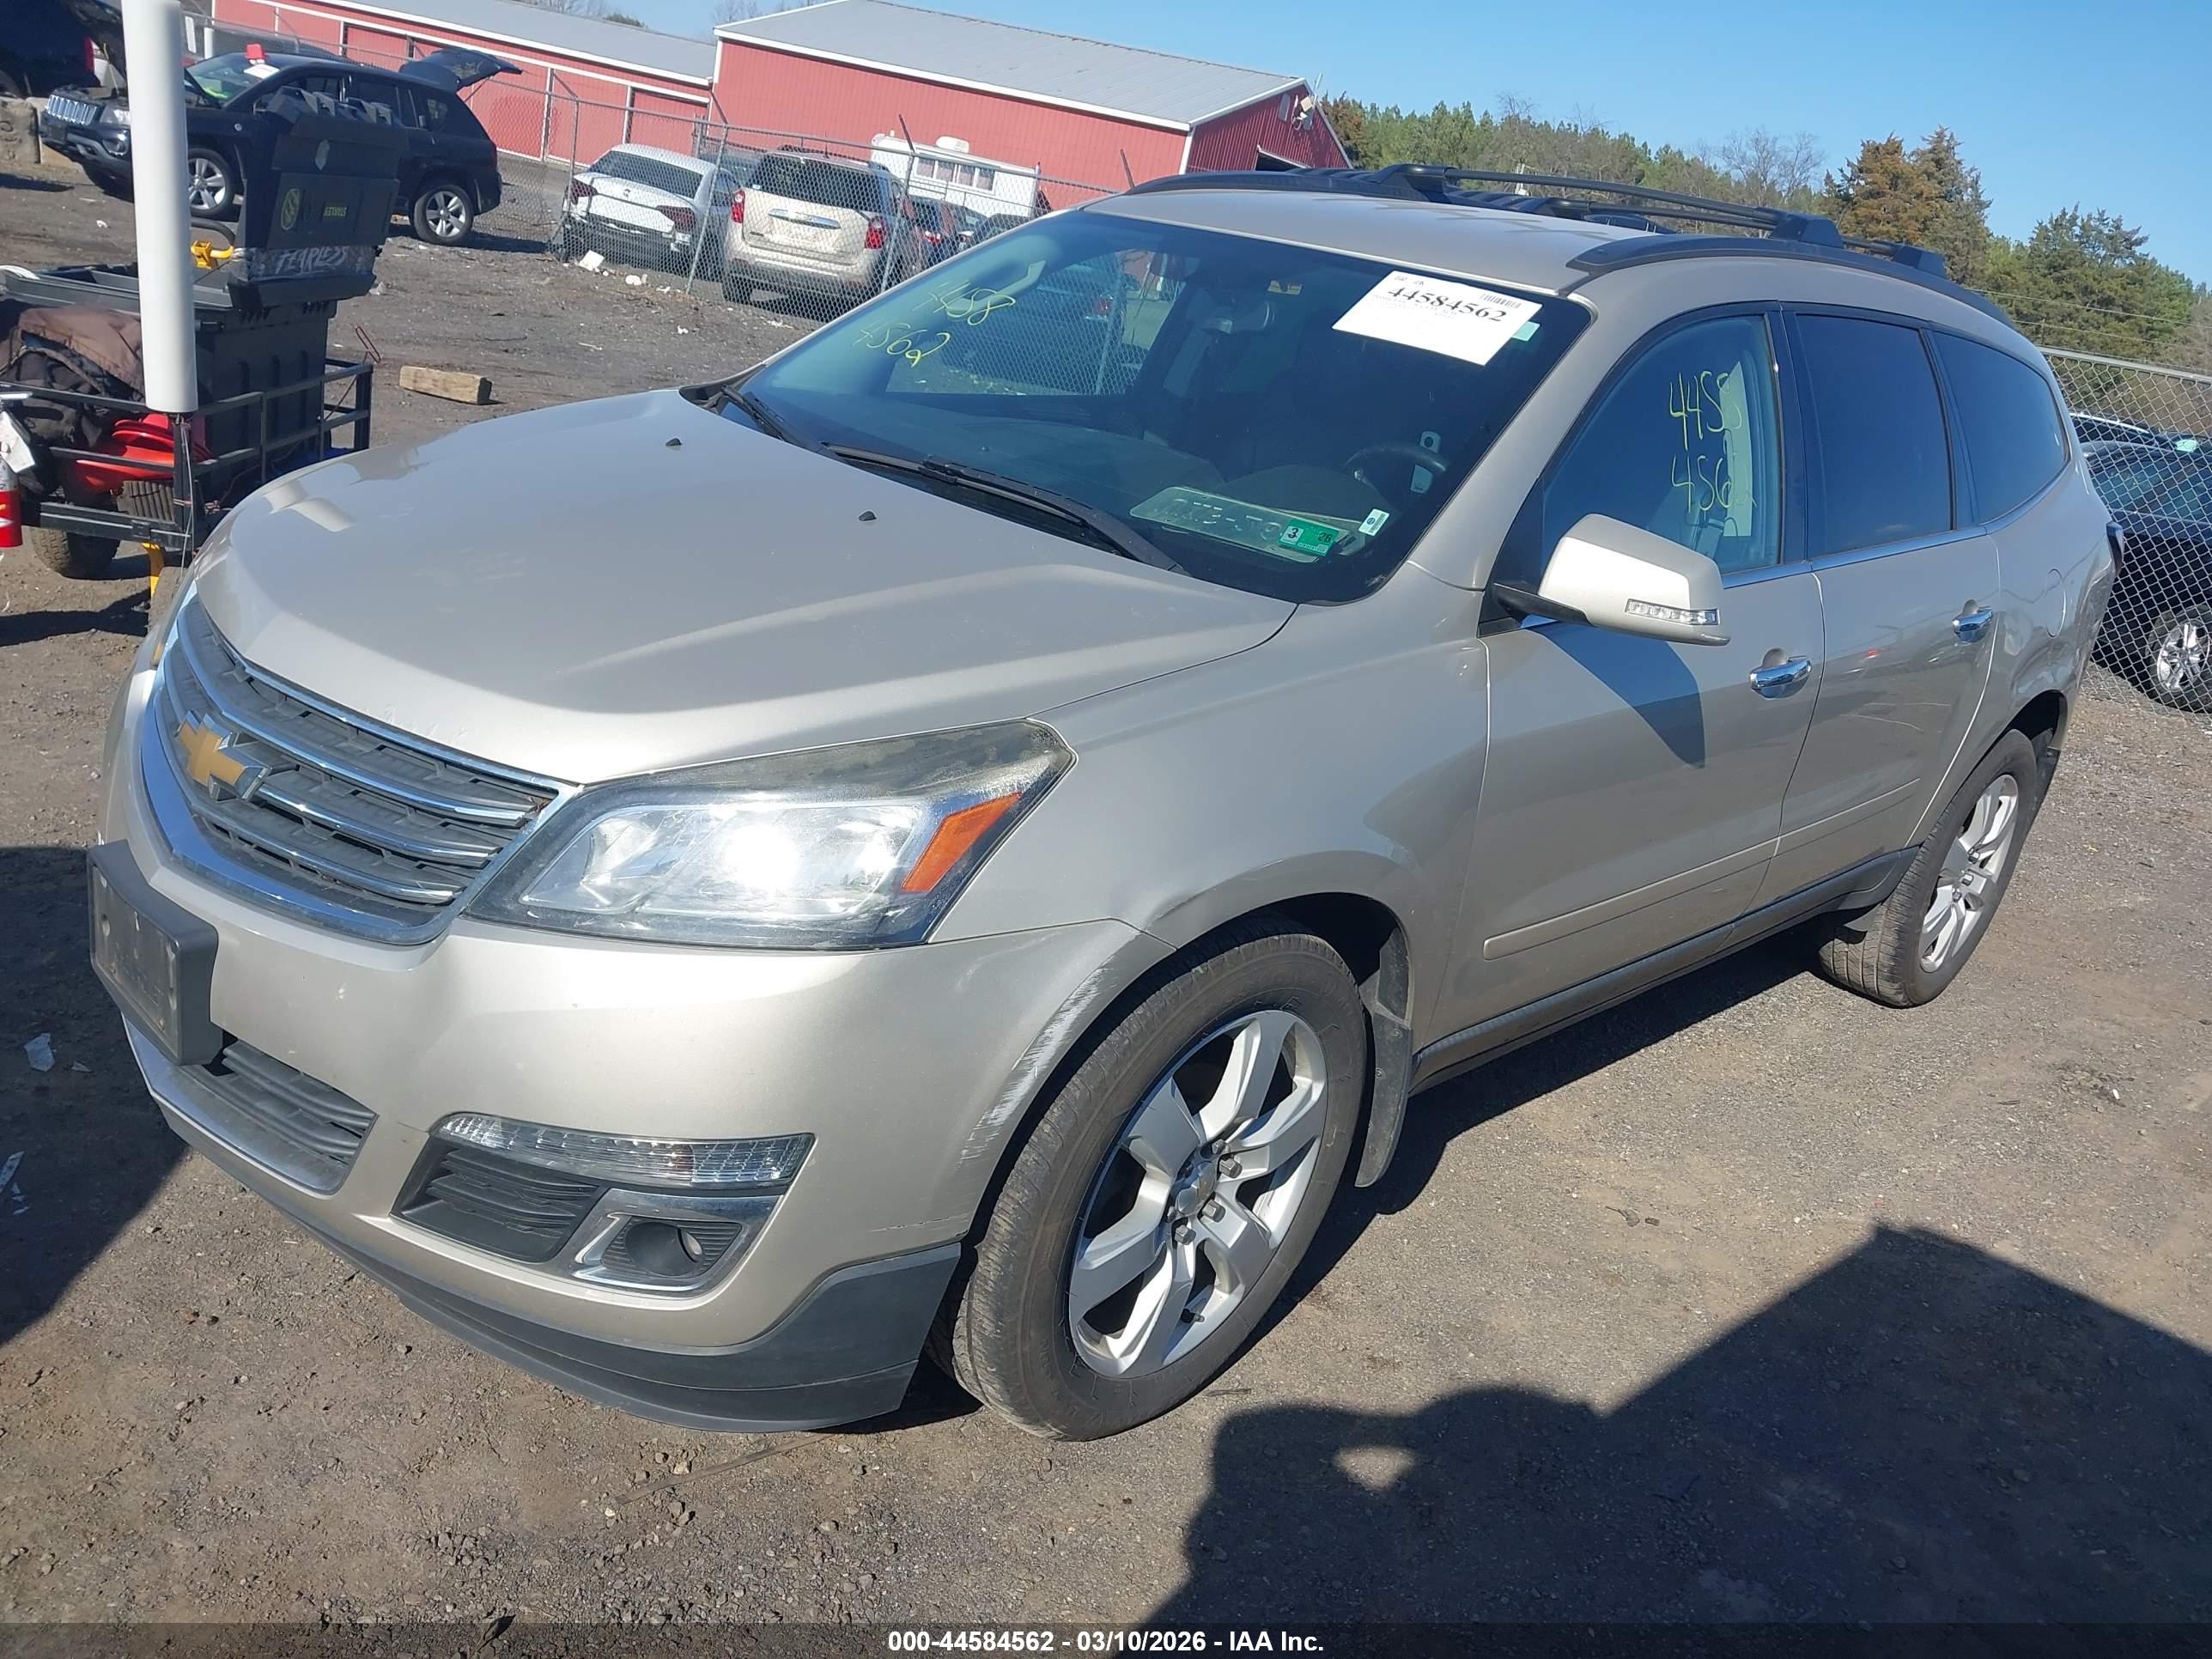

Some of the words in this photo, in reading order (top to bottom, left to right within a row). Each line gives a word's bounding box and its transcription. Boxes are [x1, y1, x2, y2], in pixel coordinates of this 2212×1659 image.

[1388, 287, 1507, 322] 44584562
[1288, 527, 1299, 538] 3
[1317, 532, 1333, 543] 26
